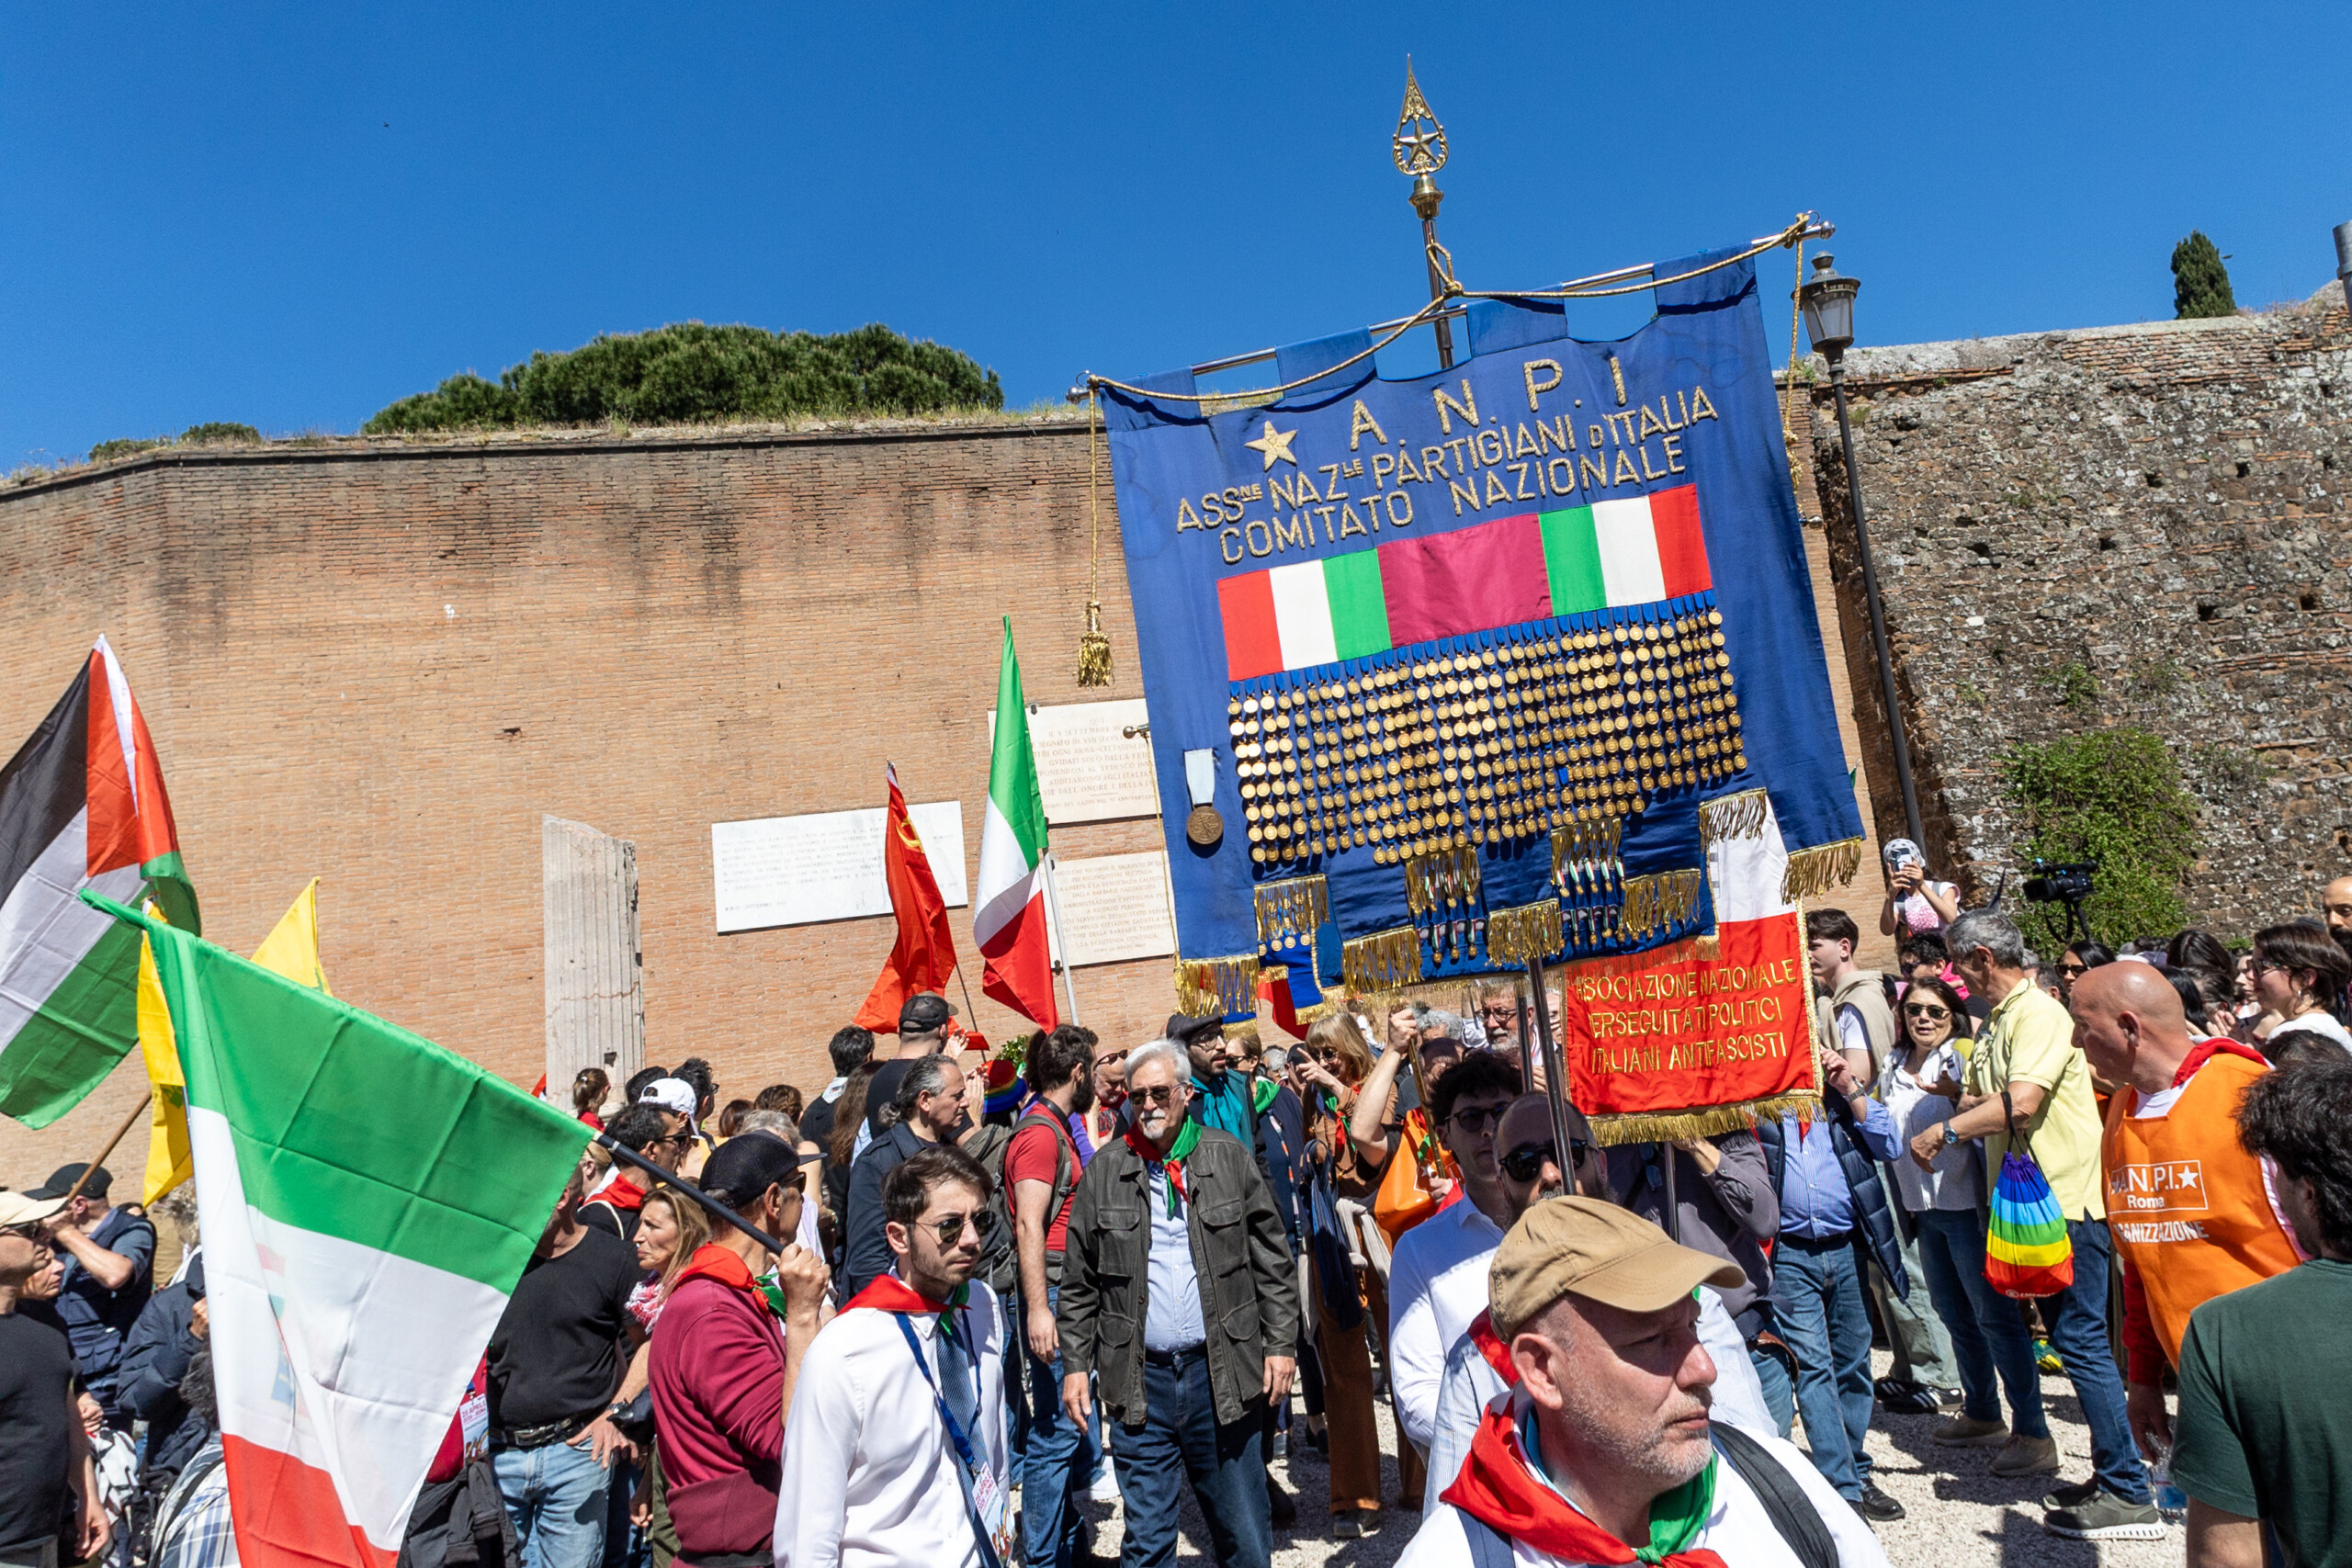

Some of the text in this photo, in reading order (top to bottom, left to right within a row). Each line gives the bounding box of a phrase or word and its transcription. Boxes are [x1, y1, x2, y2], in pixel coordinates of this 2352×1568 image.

[1610, 355, 1628, 407] I
[1372, 413, 1577, 490] PARTIGIANI
[1219, 434, 1686, 565] COMITATO NAZIONALE
[1701, 958, 1797, 995] NAZIONALE
[1589, 997, 1783, 1039] ERSEGUITATI POLITICI
[2127, 1194, 2165, 1209] Roma
[2114, 1220, 2210, 1244] GANIZZAZIONE
